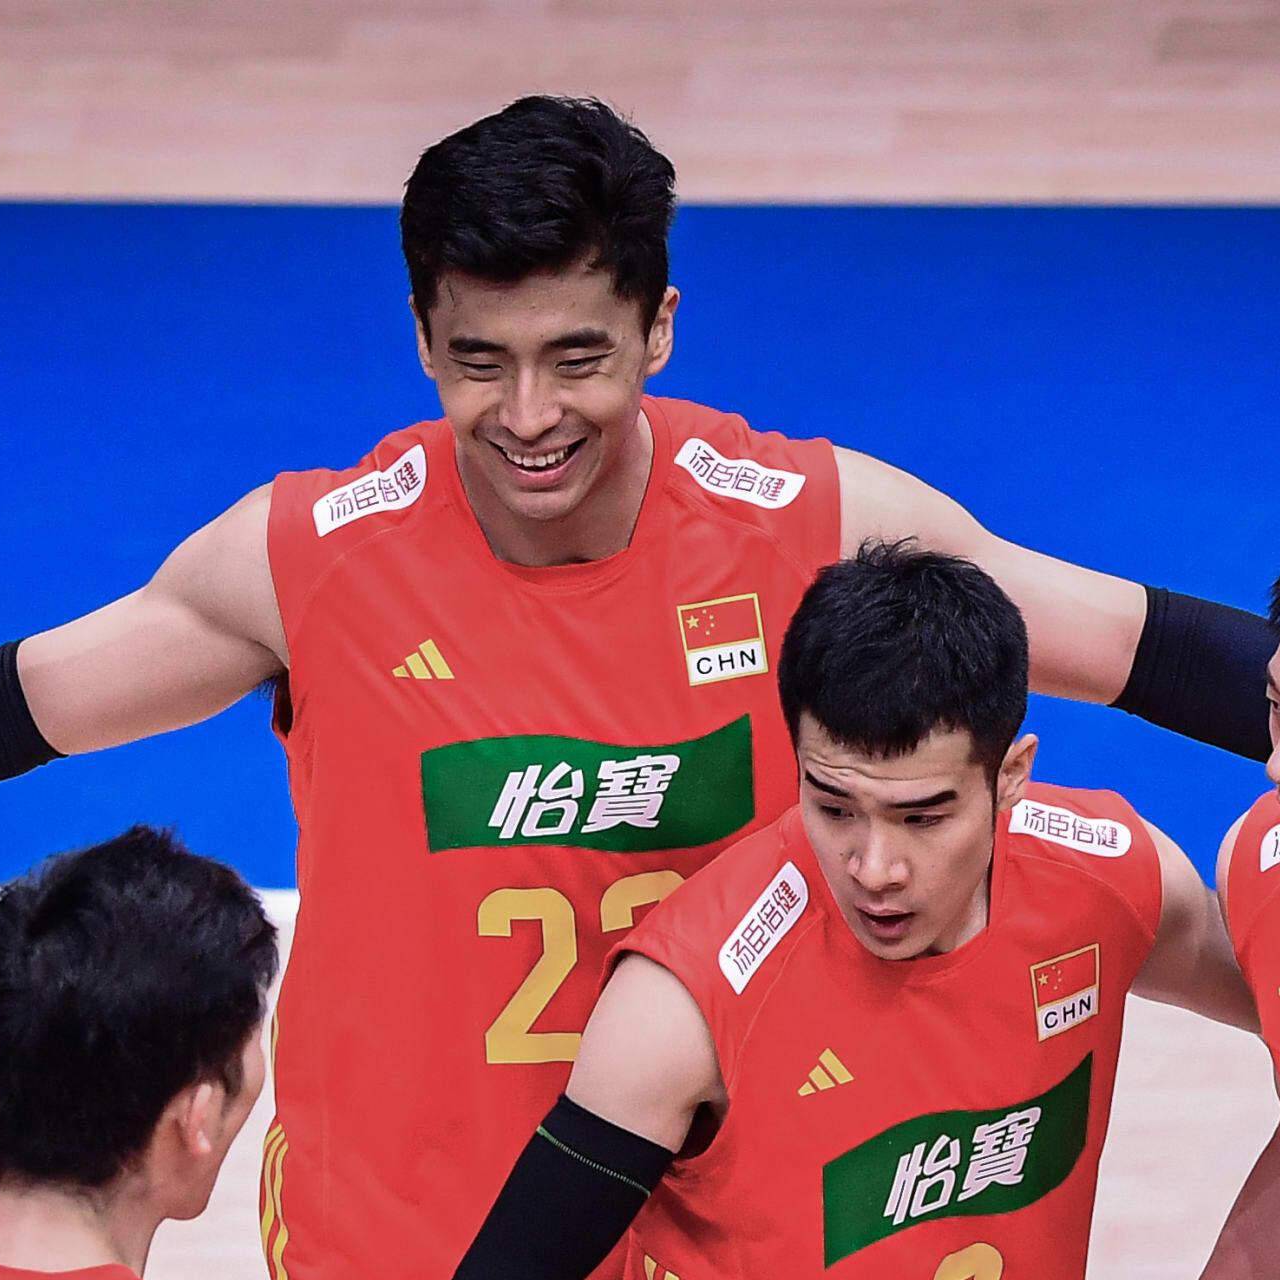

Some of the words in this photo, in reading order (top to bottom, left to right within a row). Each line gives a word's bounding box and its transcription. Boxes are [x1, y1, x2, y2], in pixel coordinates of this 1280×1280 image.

[326, 462, 422, 521] 汤臣倍健
[689, 446, 787, 502] 汤臣倍健
[696, 646, 760, 676] CHN
[487, 754, 681, 840] 怡寶
[1023, 805, 1121, 850] 汤臣倍健
[726, 880, 802, 976] 汤臣倍健
[1042, 996, 1093, 1031] CHN
[883, 1106, 1042, 1226] 怡寶
